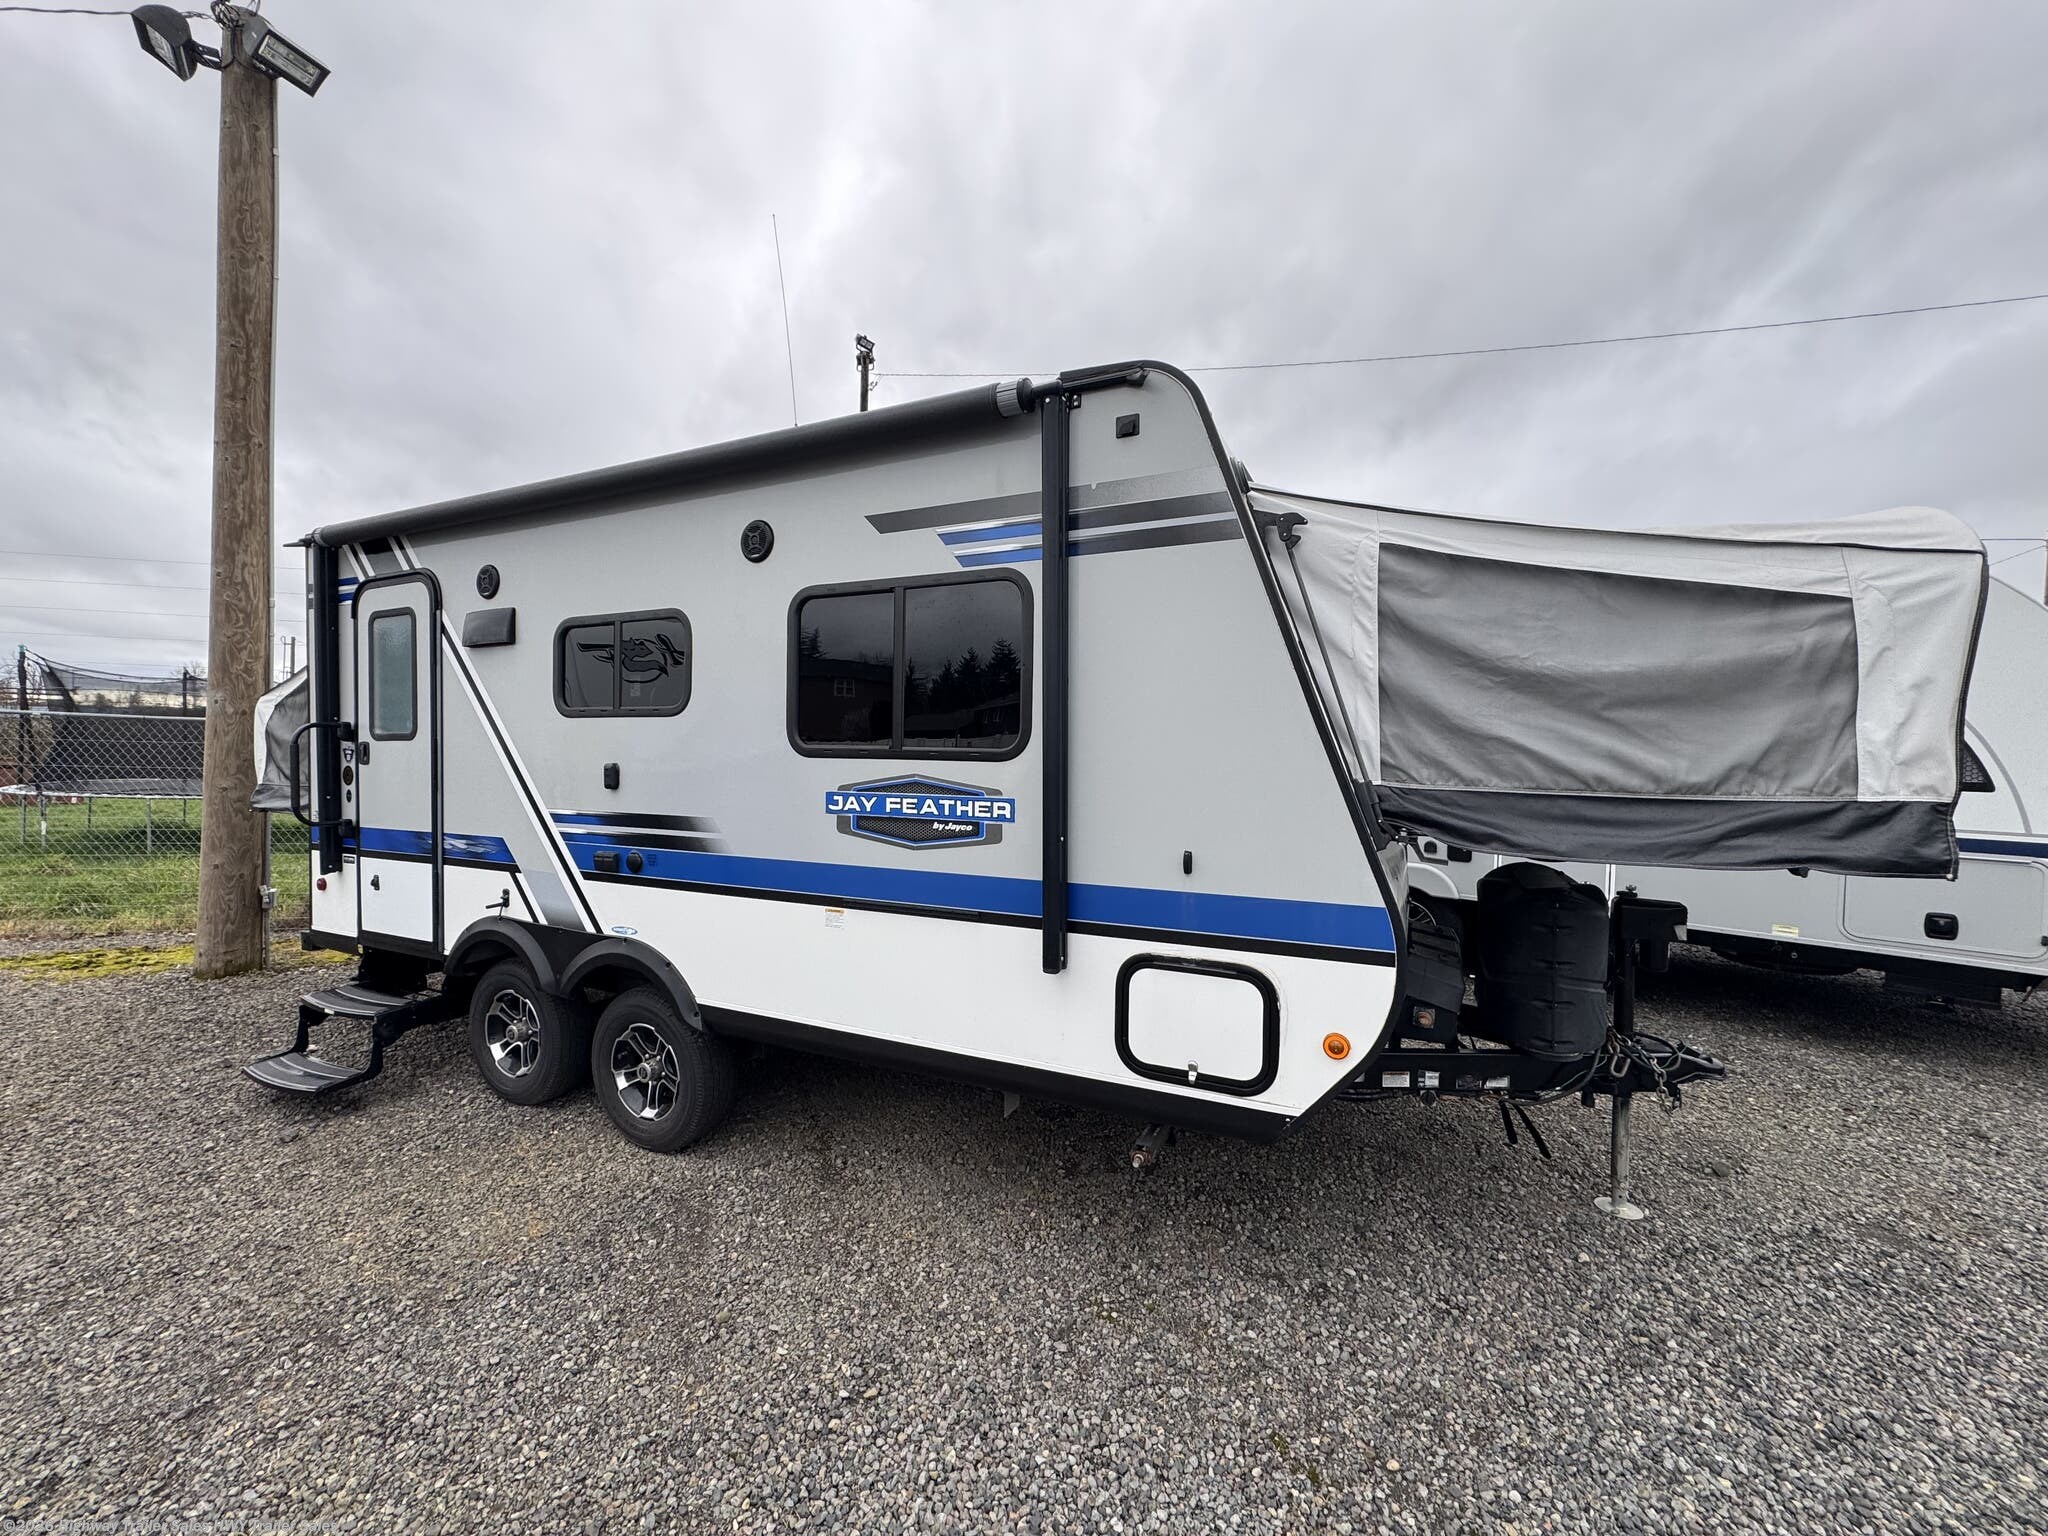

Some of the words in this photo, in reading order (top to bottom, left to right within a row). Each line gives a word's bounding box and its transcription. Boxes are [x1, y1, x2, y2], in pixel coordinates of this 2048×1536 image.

[828, 795, 877, 812] JAY
[885, 797, 1011, 819] FEATHER
[932, 821, 944, 831] by
[944, 822, 972, 832] Jayco
